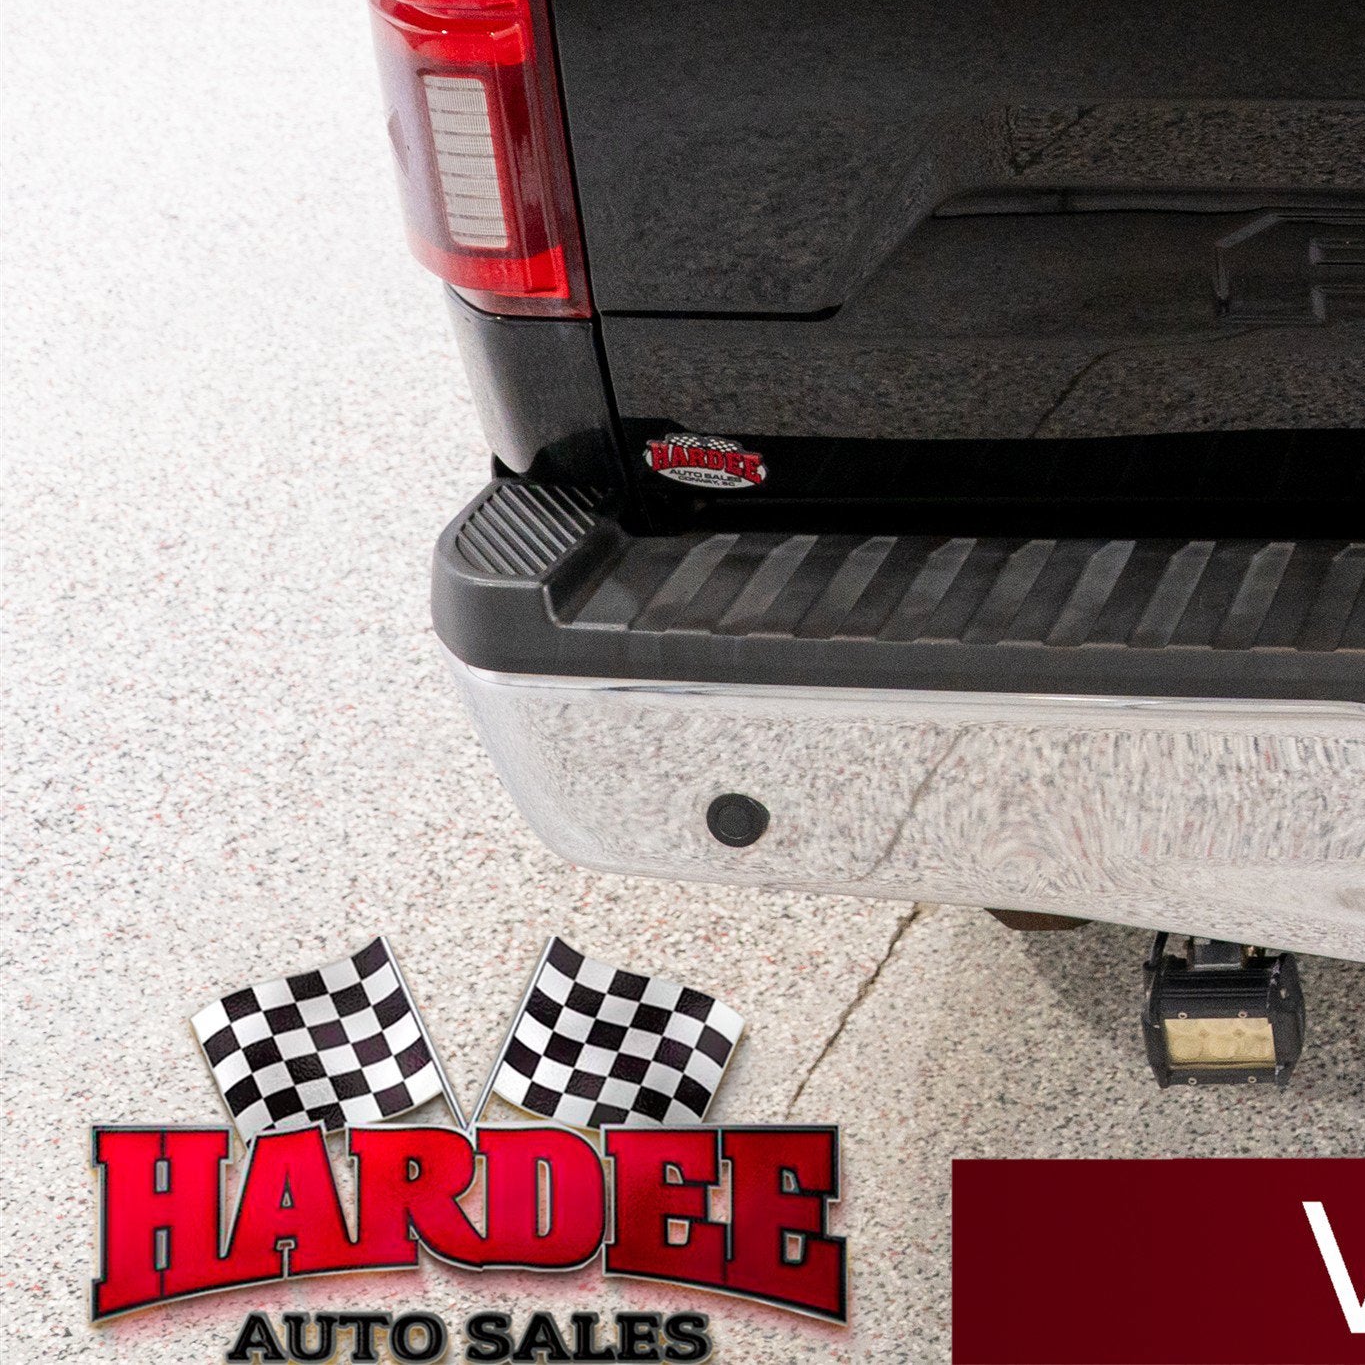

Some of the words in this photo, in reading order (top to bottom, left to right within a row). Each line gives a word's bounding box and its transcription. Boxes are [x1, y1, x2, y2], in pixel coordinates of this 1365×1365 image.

[650, 442, 763, 485] HARDEE
[669, 469, 703, 478] AUTO
[704, 472, 742, 483] SALES
